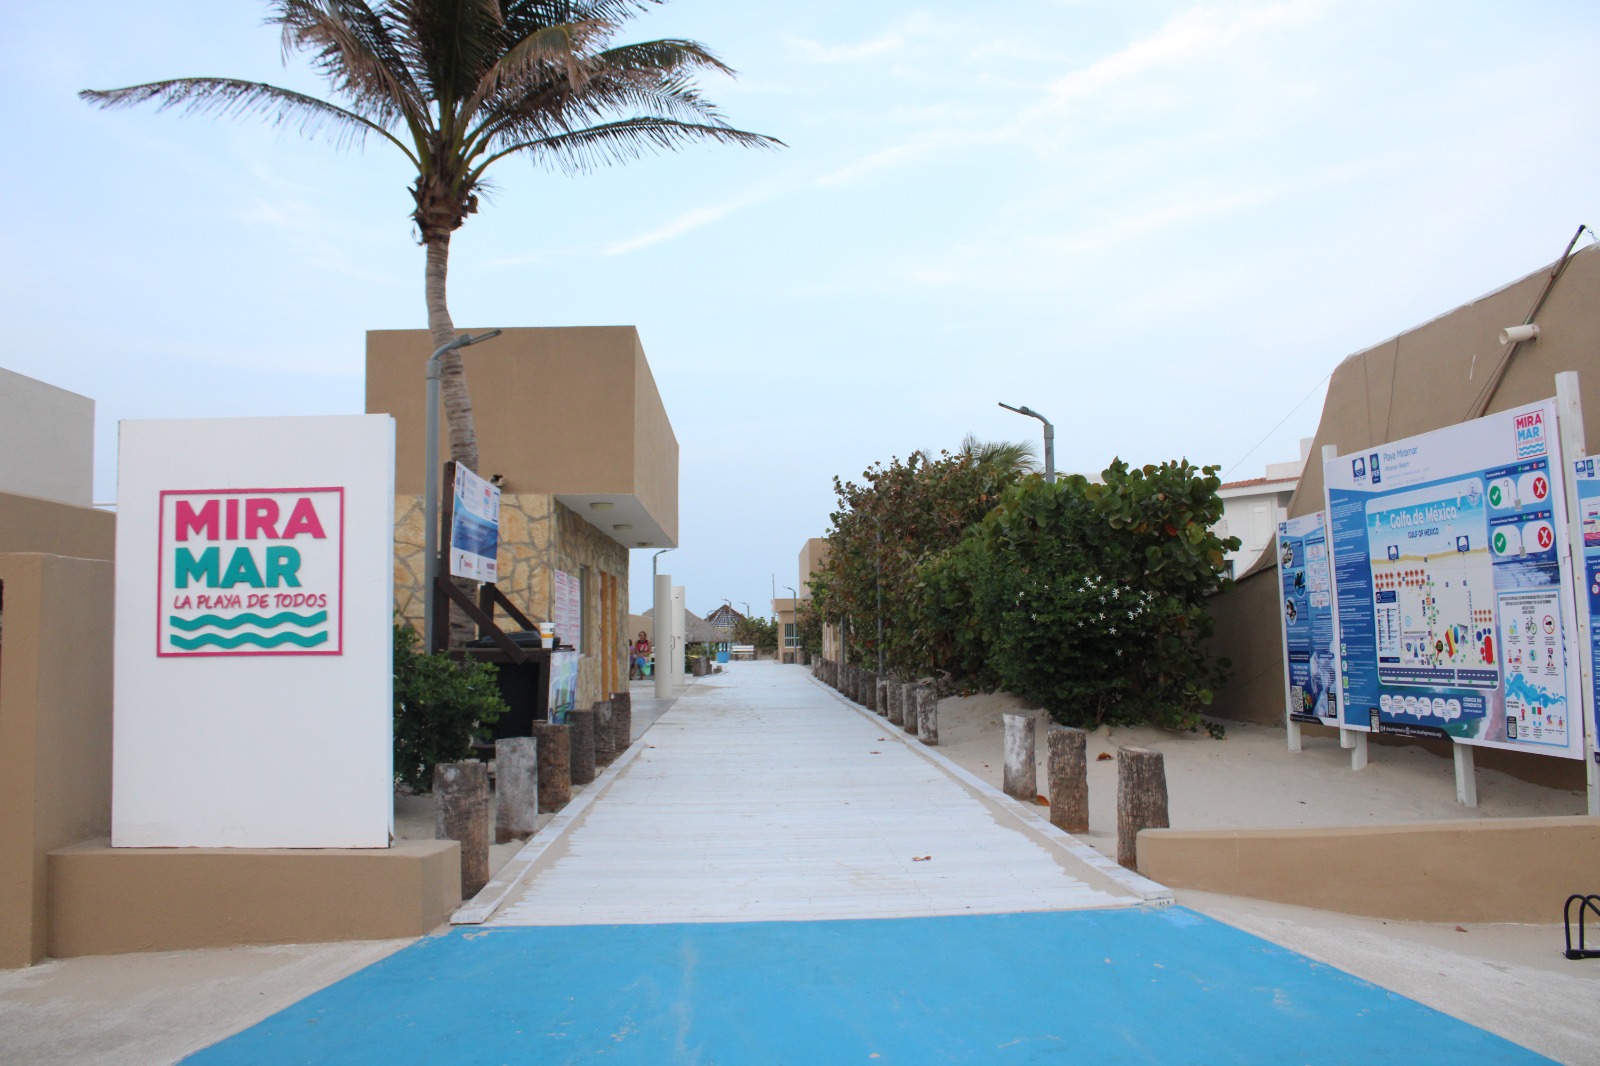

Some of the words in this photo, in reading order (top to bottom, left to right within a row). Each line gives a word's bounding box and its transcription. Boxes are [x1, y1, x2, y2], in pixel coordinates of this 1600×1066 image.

[1516, 413, 1542, 430] MIRA
[1517, 426, 1540, 441] MAR
[175, 498, 327, 541] MIRA
[1412, 508, 1425, 525] de
[1408, 530, 1418, 539] GULF
[1418, 529, 1424, 537] OF
[175, 545, 302, 588] MAR
[173, 595, 192, 610] LA
[197, 595, 242, 610] PLAYA
[247, 594, 269, 609] DE
[274, 593, 327, 608] TODOS
